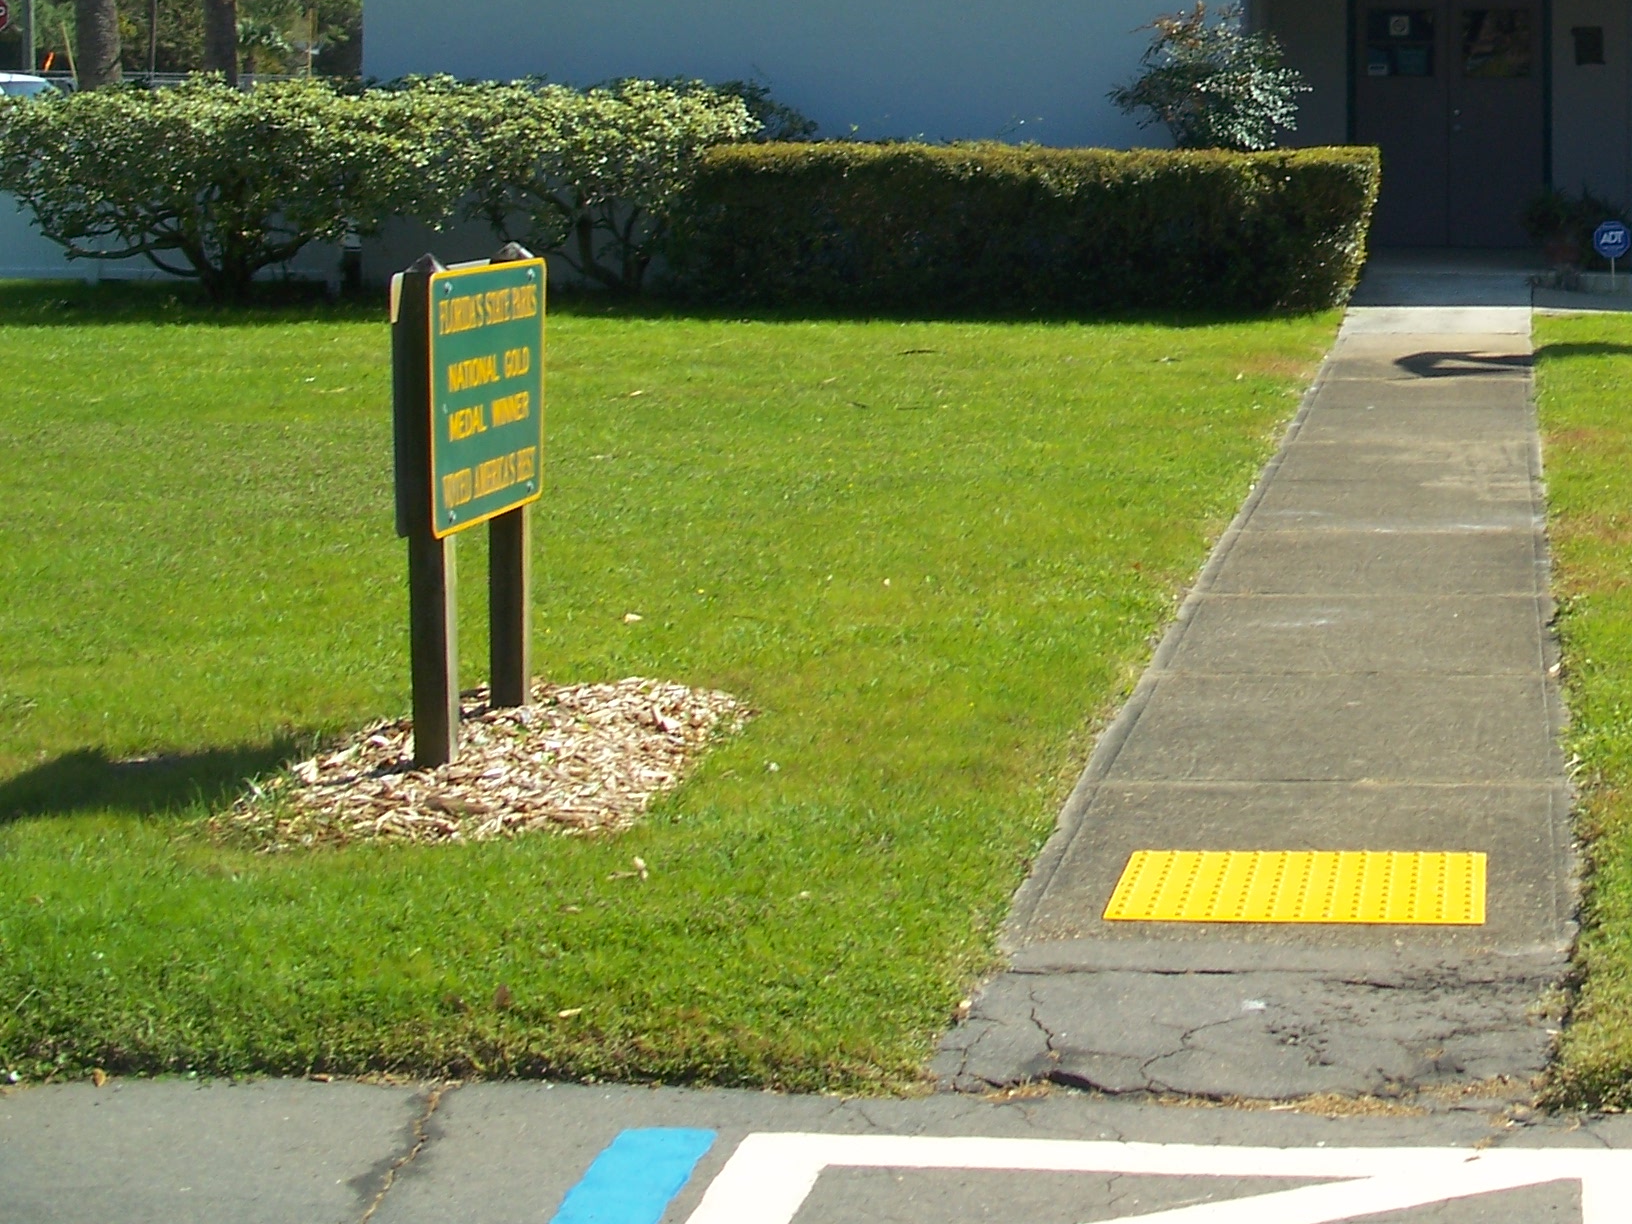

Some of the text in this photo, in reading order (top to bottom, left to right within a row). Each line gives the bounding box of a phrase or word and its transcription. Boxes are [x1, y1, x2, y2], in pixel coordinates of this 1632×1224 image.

[1599, 230, 1625, 245] ADT
[447, 346, 531, 393] NATIONAL GOLD
[448, 391, 531, 443] MEDAL WINNER
